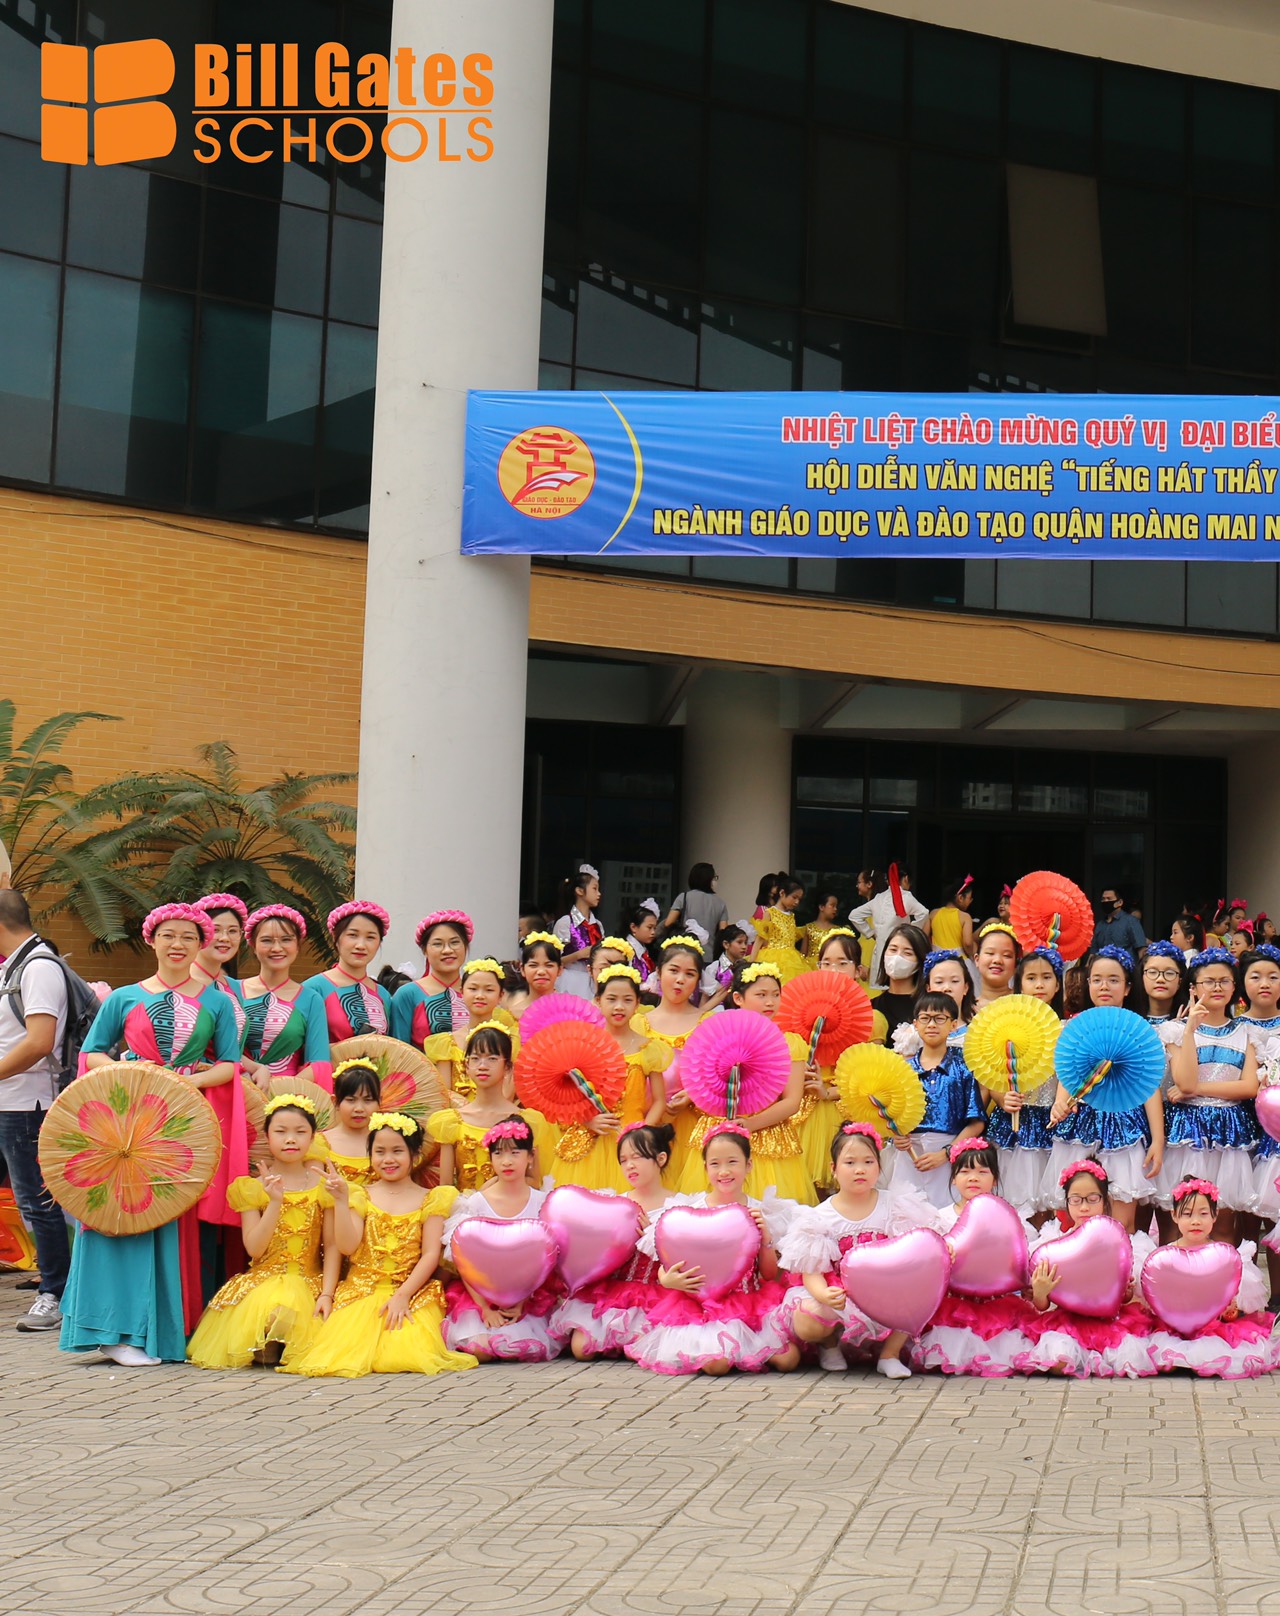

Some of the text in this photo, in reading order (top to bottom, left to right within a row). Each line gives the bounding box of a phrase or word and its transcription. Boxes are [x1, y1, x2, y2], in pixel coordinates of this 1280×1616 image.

[782, 412, 857, 449] NHIỆT
[863, 412, 917, 449] LIỆT
[922, 412, 992, 445] CHÀO
[999, 413, 1078, 445] MỪNG
[1084, 413, 1136, 448] QUÝ
[1141, 420, 1168, 452] VỊ
[1181, 420, 1225, 452] ĐẠI
[806, 458, 850, 495] HỘI
[856, 454, 918, 490] DIỄN
[924, 459, 977, 491] VĂN
[984, 460, 1054, 496] NGHỆ
[1157, 461, 1207, 493] HÁT
[1213, 459, 1278, 494] THẦY
[653, 504, 743, 536] NGÀNH
[750, 505, 810, 536] GIÁO
[817, 510, 870, 542] DỤC
[876, 505, 910, 537] VÀ
[917, 506, 969, 538] ĐÀO
[976, 511, 1026, 543] TẠO
[1032, 507, 1104, 544] QUẬN
[1111, 508, 1199, 540] HOÀNG
[1206, 514, 1257, 540] MAI
